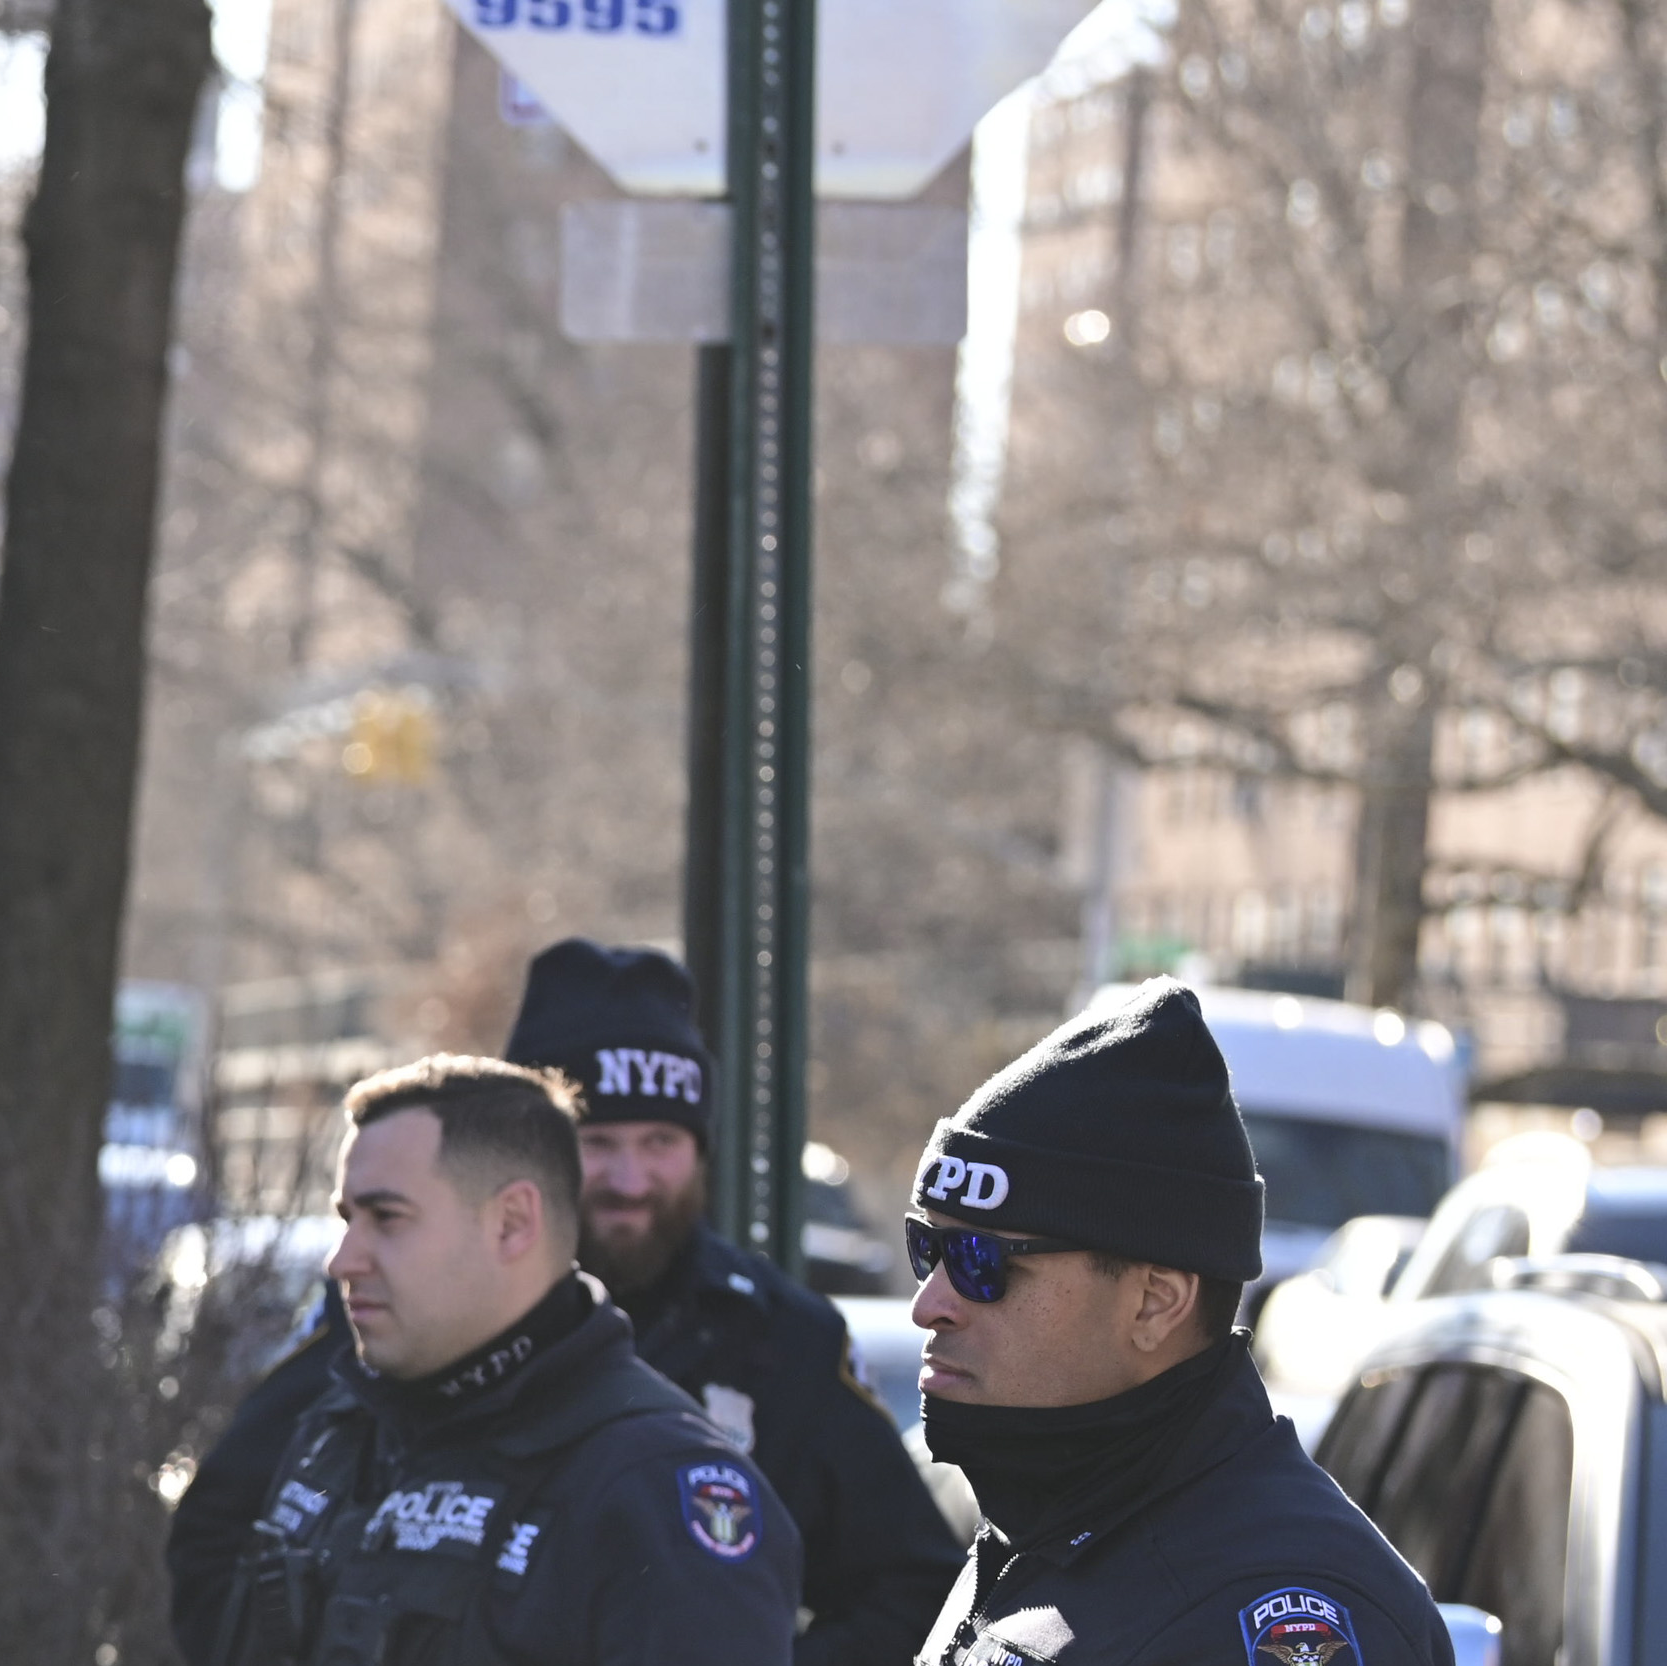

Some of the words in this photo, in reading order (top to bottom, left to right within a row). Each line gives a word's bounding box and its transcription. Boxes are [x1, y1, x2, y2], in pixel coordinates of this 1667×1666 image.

[594, 1048, 702, 1104] NYPD
[920, 1154, 1009, 1211] PD
[687, 1465, 751, 1498] POLICE
[366, 1489, 495, 1533] POLICE
[1253, 1594, 1339, 1629] POLICE
[1284, 1623, 1316, 1632] NYPD
